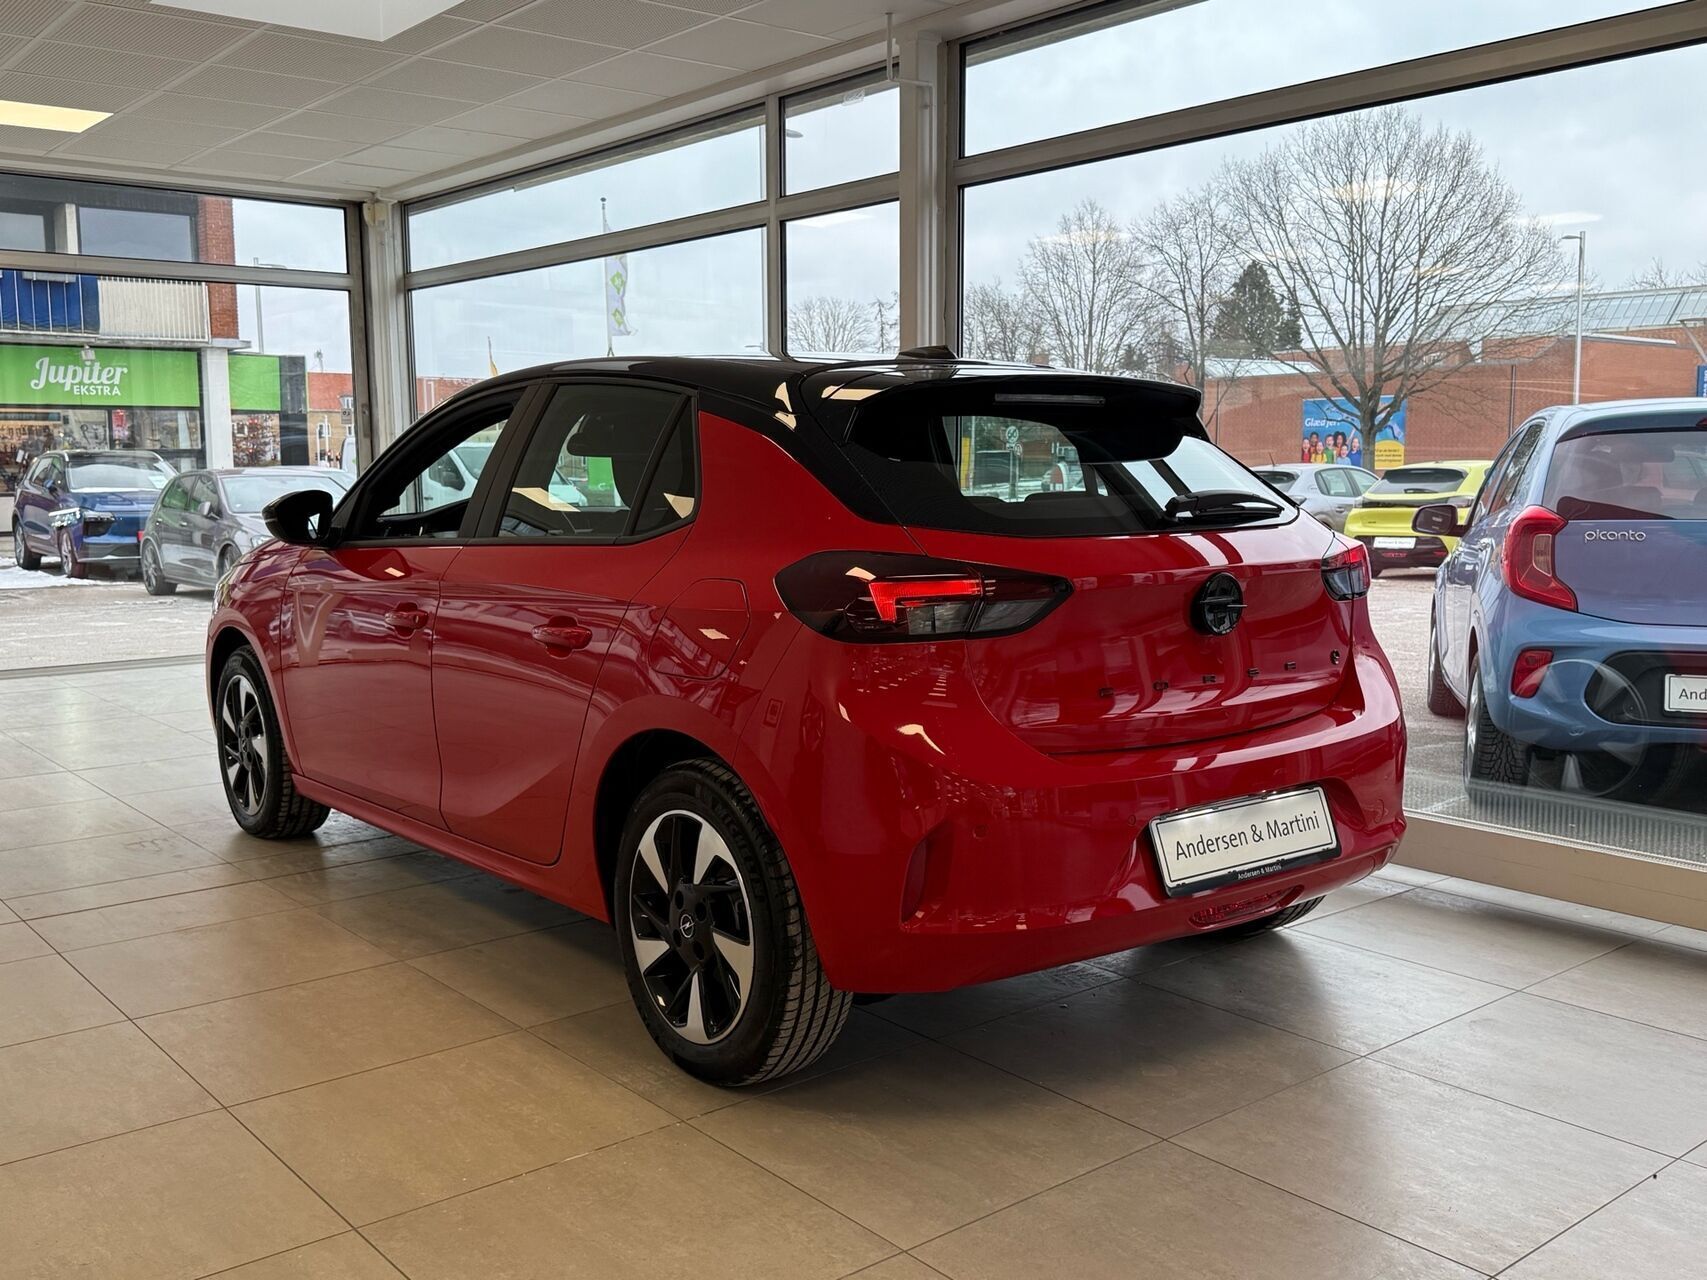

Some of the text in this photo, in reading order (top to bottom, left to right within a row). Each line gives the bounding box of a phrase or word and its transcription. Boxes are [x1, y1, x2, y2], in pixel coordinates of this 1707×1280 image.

[30, 356, 128, 391] Jupiter
[73, 385, 121, 396] EKSTRA
[1584, 529, 1647, 544] picanto
[1176, 811, 1320, 860] Andersen & Martini
[1238, 869, 1261, 880] Andersen
[1265, 863, 1282, 873] Martini
